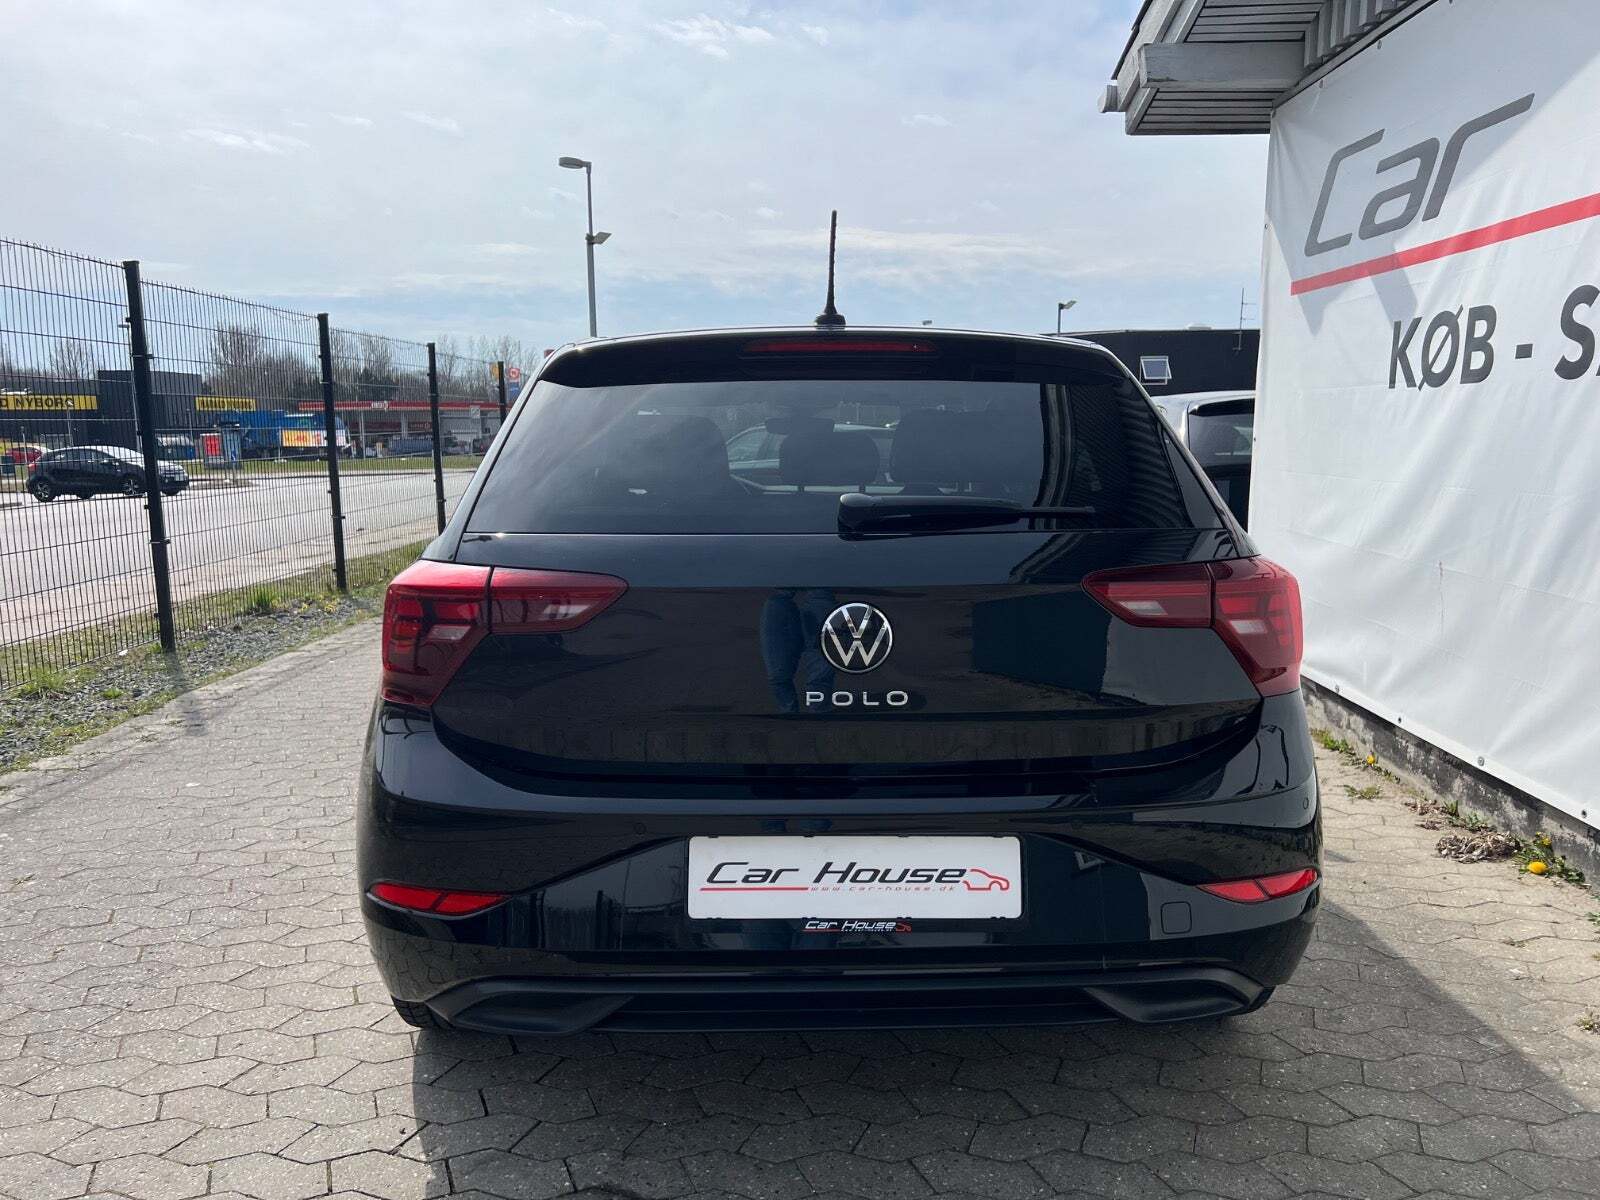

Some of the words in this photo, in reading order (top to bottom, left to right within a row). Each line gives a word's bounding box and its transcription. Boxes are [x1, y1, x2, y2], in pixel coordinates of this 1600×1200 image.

[1304, 92, 1535, 257] Car
[1388, 304, 1497, 391] KØB
[1554, 284, 1600, 380] S
[805, 690, 909, 706] POLO
[706, 861, 799, 884] Car
[813, 861, 967, 884] House
[805, 920, 838, 929] Car
[841, 920, 896, 930] House
